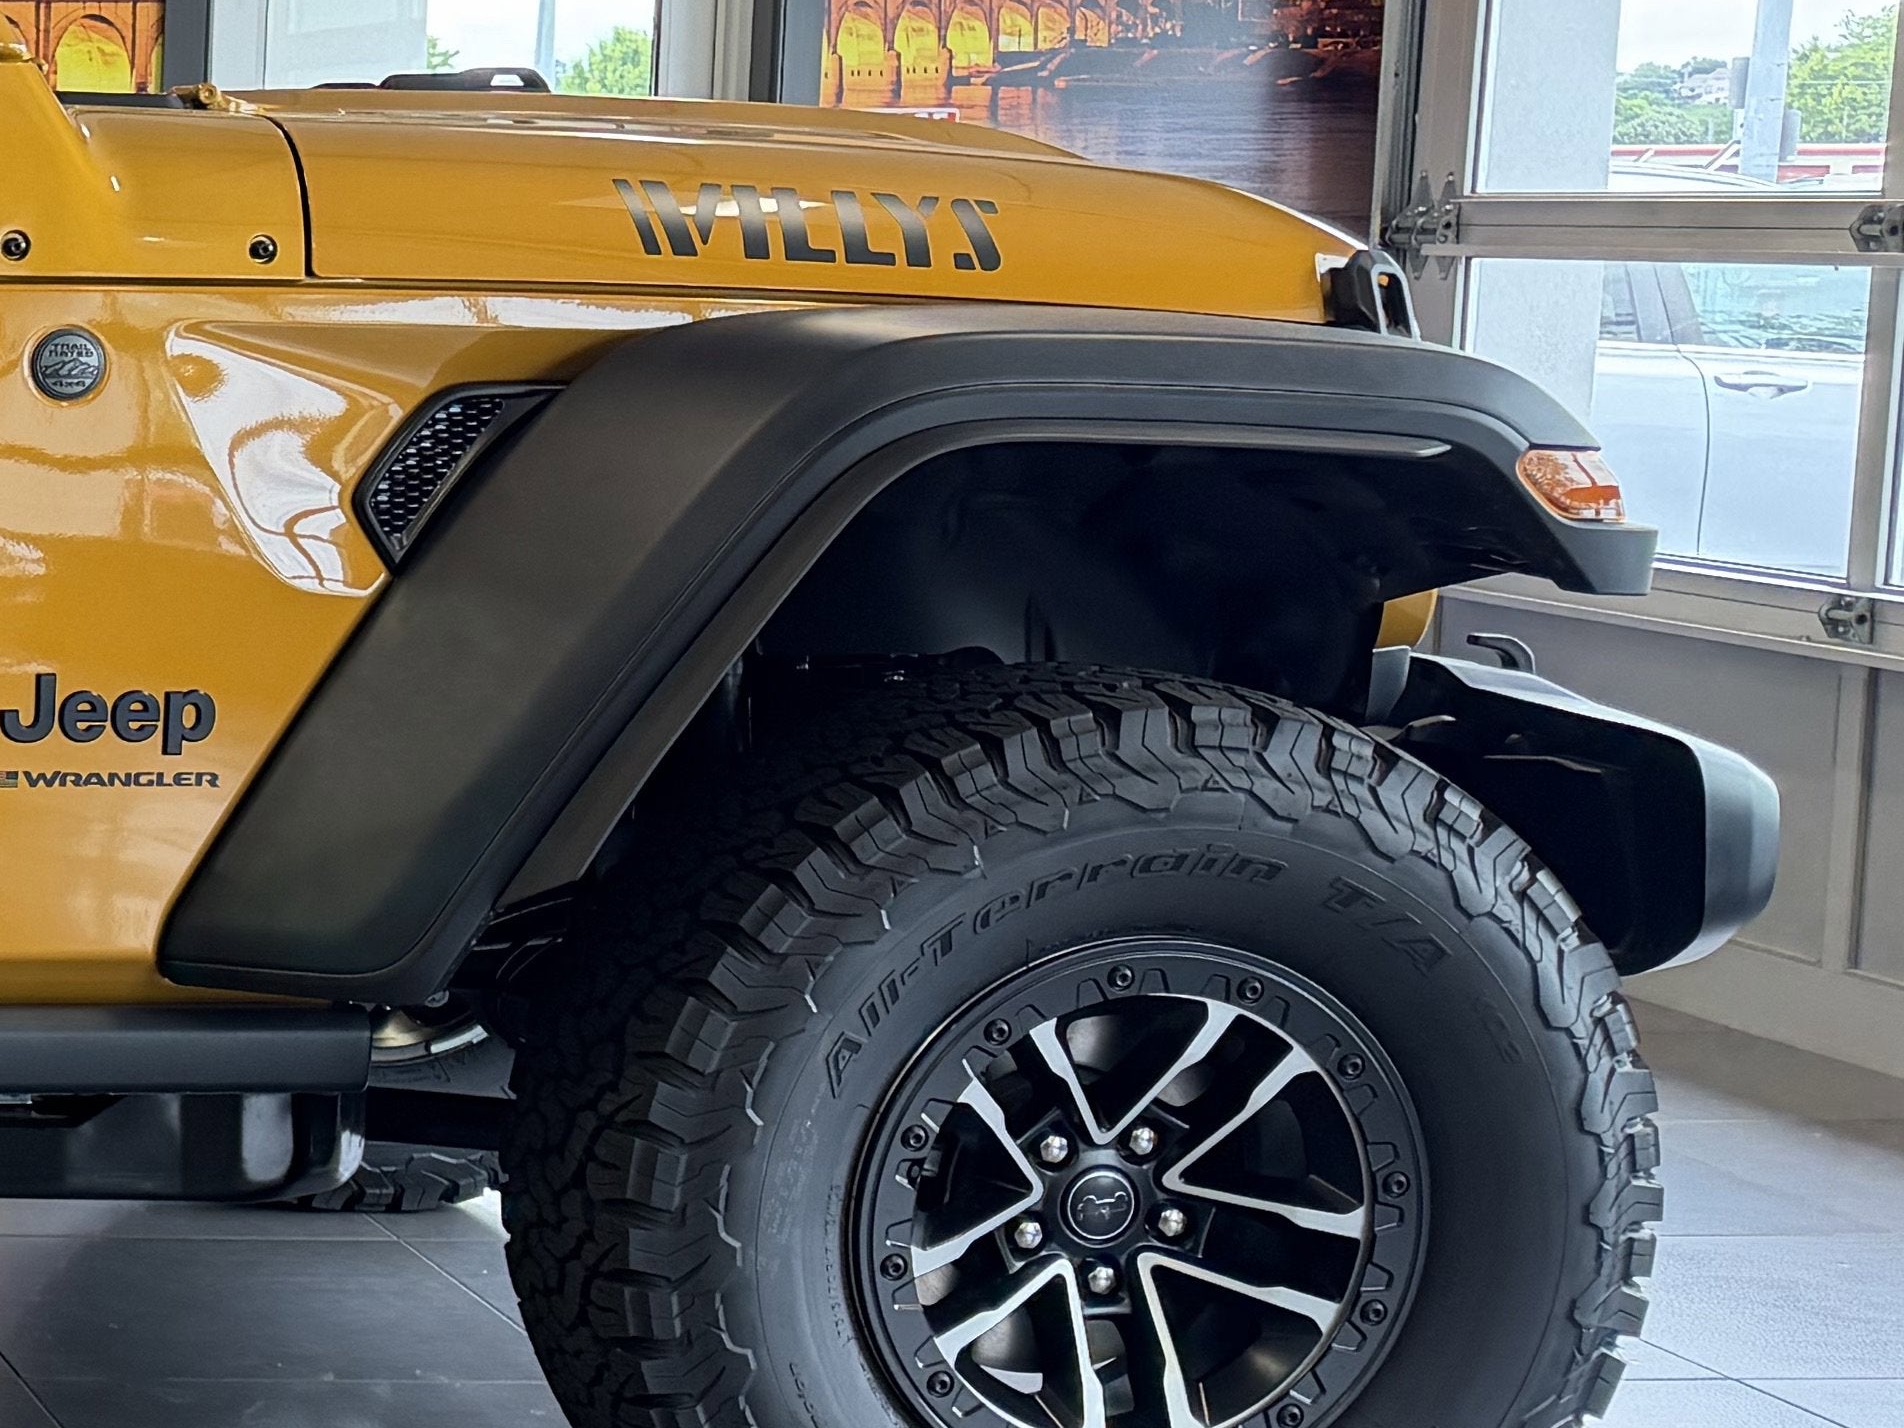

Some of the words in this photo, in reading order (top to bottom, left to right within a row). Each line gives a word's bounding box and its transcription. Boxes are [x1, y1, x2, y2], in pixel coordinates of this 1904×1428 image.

[612, 178, 1002, 272] WILLYS
[22, 770, 221, 788] WRANGLER
[825, 844, 1289, 1100] All-Terrain
[1322, 874, 1453, 973] T/A
